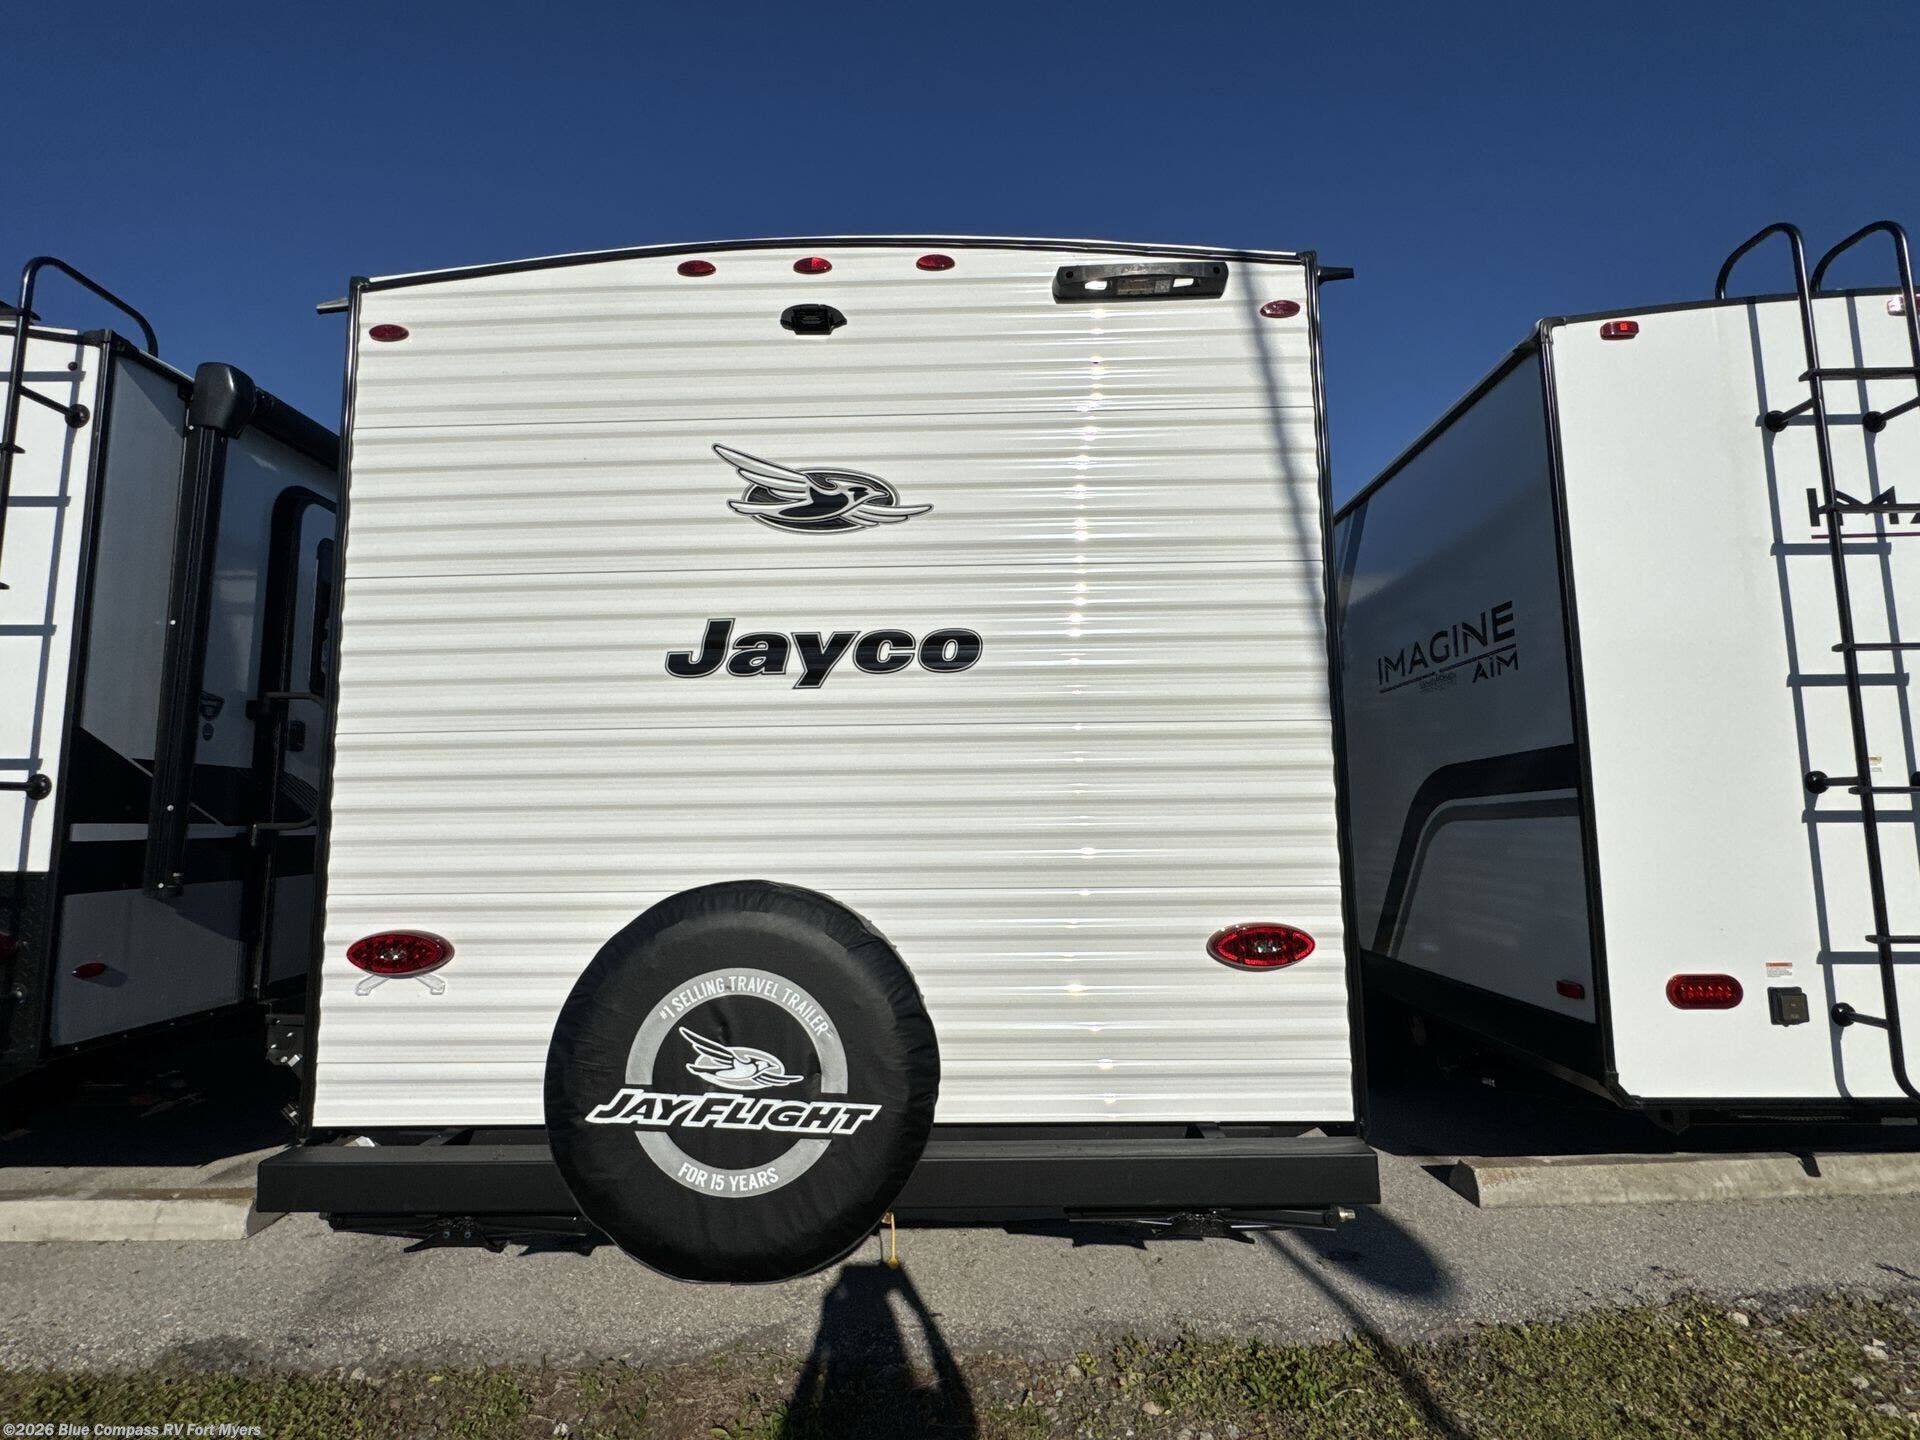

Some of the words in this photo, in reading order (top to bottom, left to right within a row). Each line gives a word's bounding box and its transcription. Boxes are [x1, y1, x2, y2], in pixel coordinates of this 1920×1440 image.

[664, 618, 984, 690] Jayco
[1377, 600, 1516, 686] IMAGINE
[1472, 650, 1519, 684] AIM
[658, 1003, 676, 1021] #1
[671, 977, 725, 1012] SELLING
[728, 975, 779, 999] TRAVEL
[677, 1162, 708, 1188] FOR
[710, 1172, 725, 1191] 15
[729, 1167, 780, 1192] YEARS
